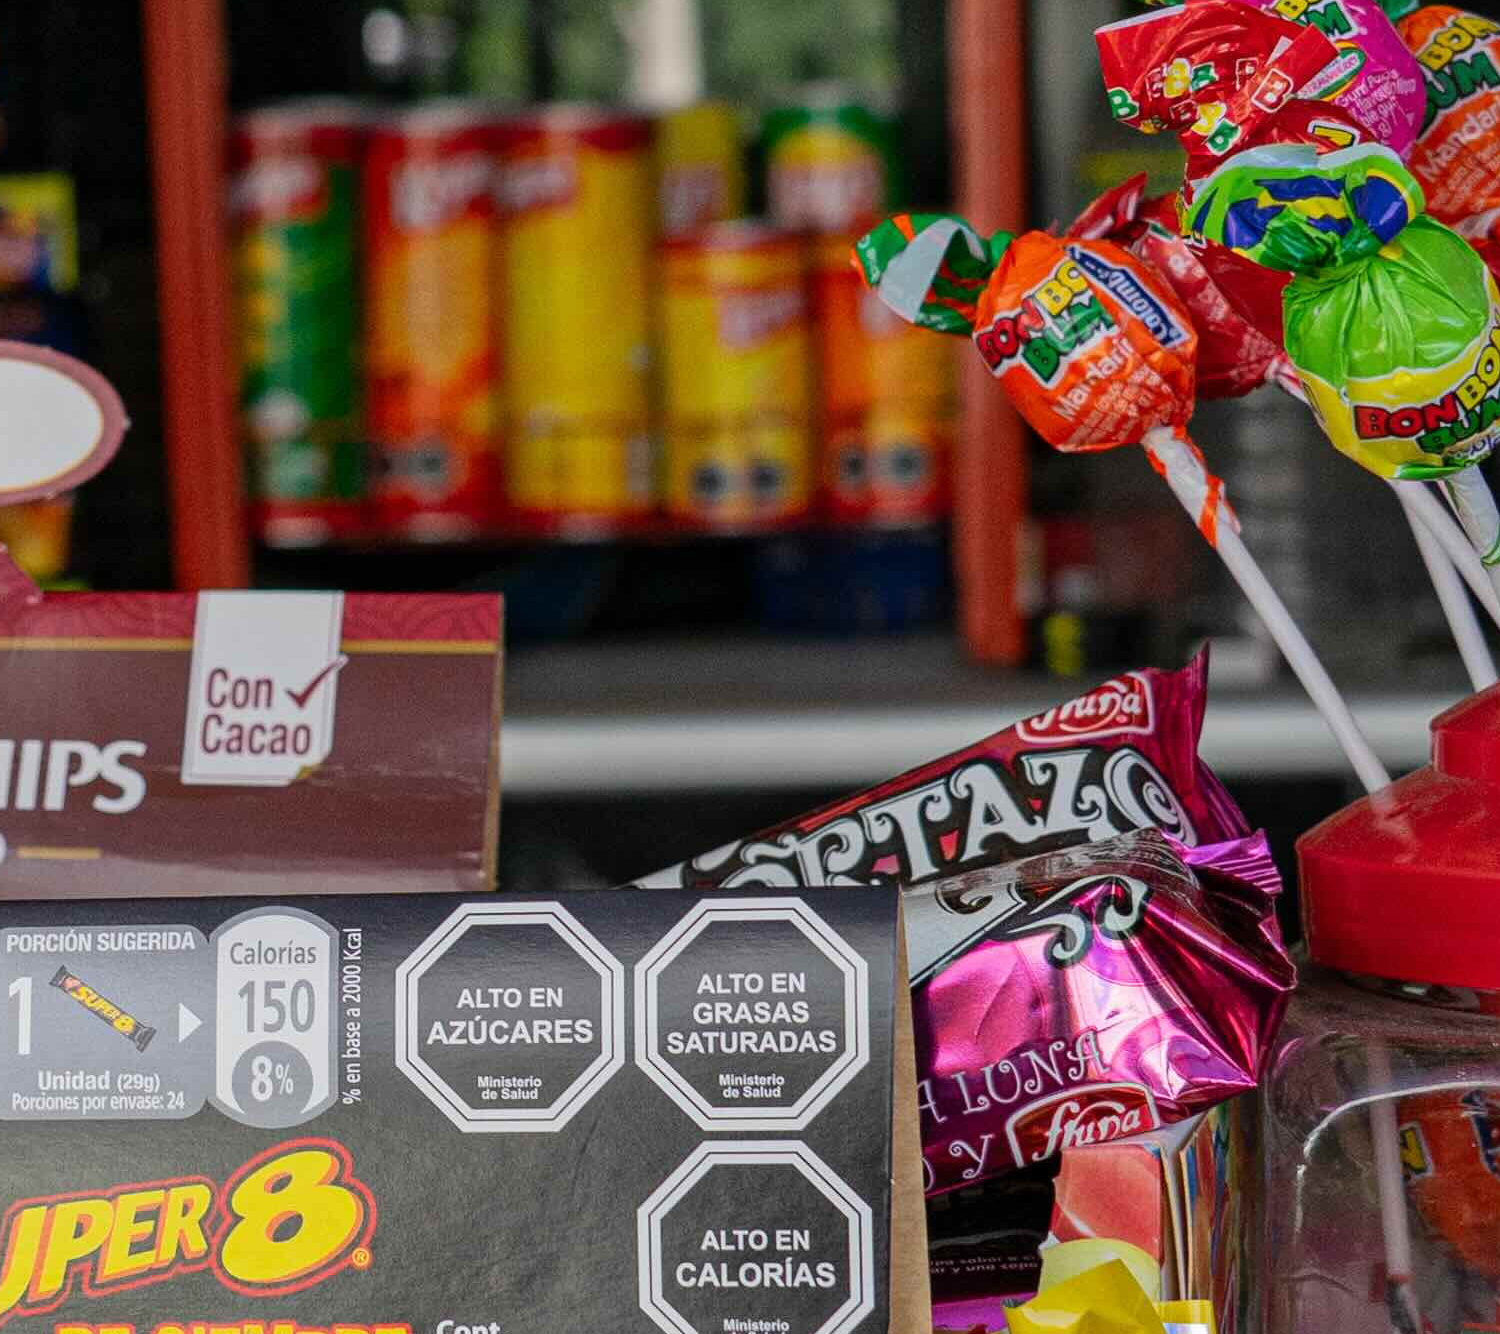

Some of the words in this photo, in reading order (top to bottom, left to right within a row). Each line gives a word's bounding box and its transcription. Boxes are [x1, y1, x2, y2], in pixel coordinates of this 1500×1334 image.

[1356, 396, 1459, 440] BON
[207, 667, 274, 711] Con
[201, 713, 312, 758] Cacao
[6, 929, 94, 954] PORCIÓN
[98, 931, 196, 952] SUGERIDA
[229, 939, 318, 966] Calorías
[342, 928, 363, 961] Kcal
[342, 963, 363, 1002] 2000
[696, 973, 764, 995] ALTO
[771, 972, 806, 993] EN
[237, 978, 316, 1034] 150
[456, 987, 522, 1010] ALTO
[530, 987, 563, 1009] EN
[8, 976, 33, 1056] 1
[692, 1001, 811, 1025] GRASAS
[342, 1019, 363, 1056] base
[426, 1015, 594, 1046] AZÚCARES
[666, 1029, 837, 1055] SATURADAS
[38, 1071, 111, 1091] Unidad
[117, 1072, 161, 1094] (29g)
[346, 1058, 363, 1083] en
[477, 1075, 543, 1089] Ministerio
[718, 1073, 786, 1088] Ministerio
[960, 1028, 1109, 1117] LUNA
[12, 1091, 80, 1112] Porciones
[83, 1095, 107, 1114] por
[110, 1091, 165, 1110] envase:
[167, 1090, 187, 1109] 24
[481, 1088, 498, 1100] de
[500, 1087, 539, 1101] Salud
[722, 1087, 738, 1099] de
[741, 1086, 782, 1099] Salud
[221, 1147, 366, 1281] 8
[699, 1229, 769, 1252] ALTO
[775, 1229, 811, 1251] EN
[675, 1257, 837, 1289] CALORÍAS
[723, 1319, 790, 1333] Ministerio
